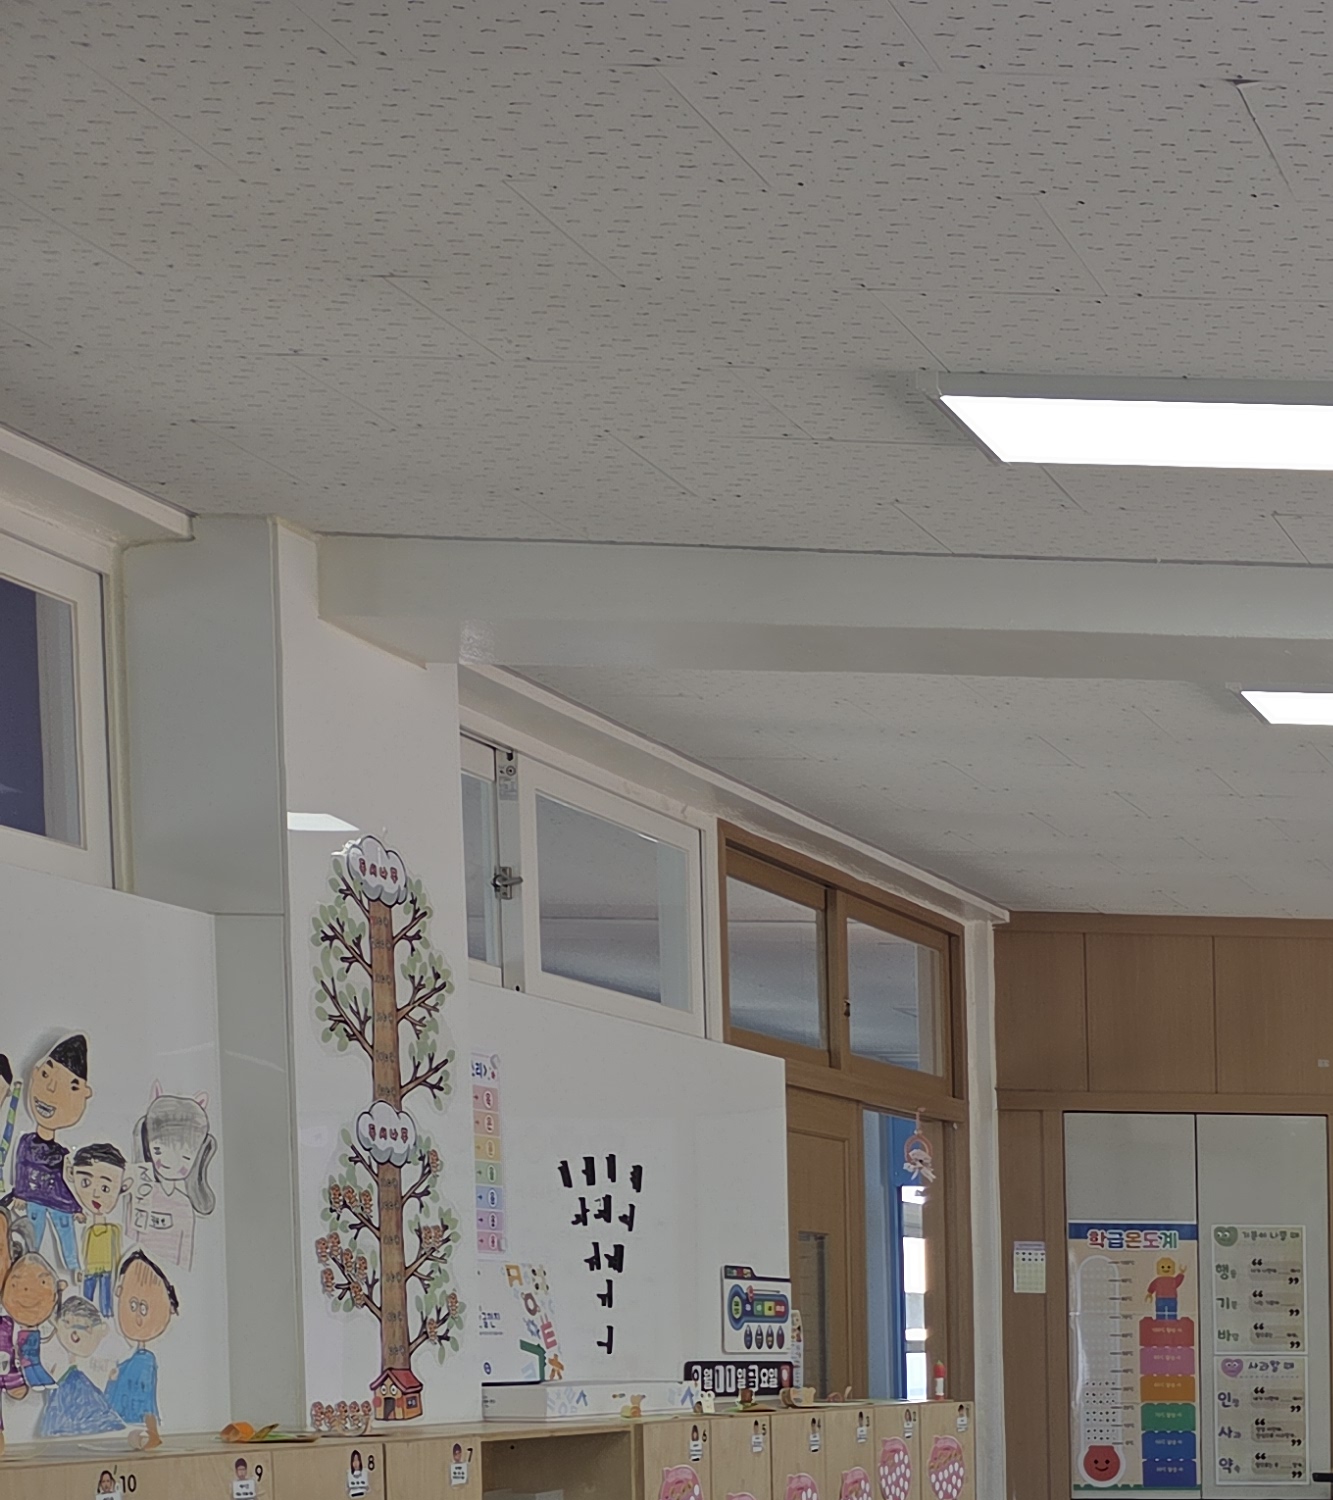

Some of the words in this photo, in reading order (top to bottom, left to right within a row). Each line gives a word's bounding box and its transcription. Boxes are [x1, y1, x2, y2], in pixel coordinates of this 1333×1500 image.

[1088, 1230, 1178, 1249] 학급온도계
[761, 1424, 767, 1437] 5
[816, 1417, 822, 1430] 4
[701, 1430, 708, 1443] 6
[367, 1454, 376, 1472] 8
[466, 1447, 474, 1463] 7
[254, 1464, 264, 1483] 9
[119, 1474, 138, 1493] 10
